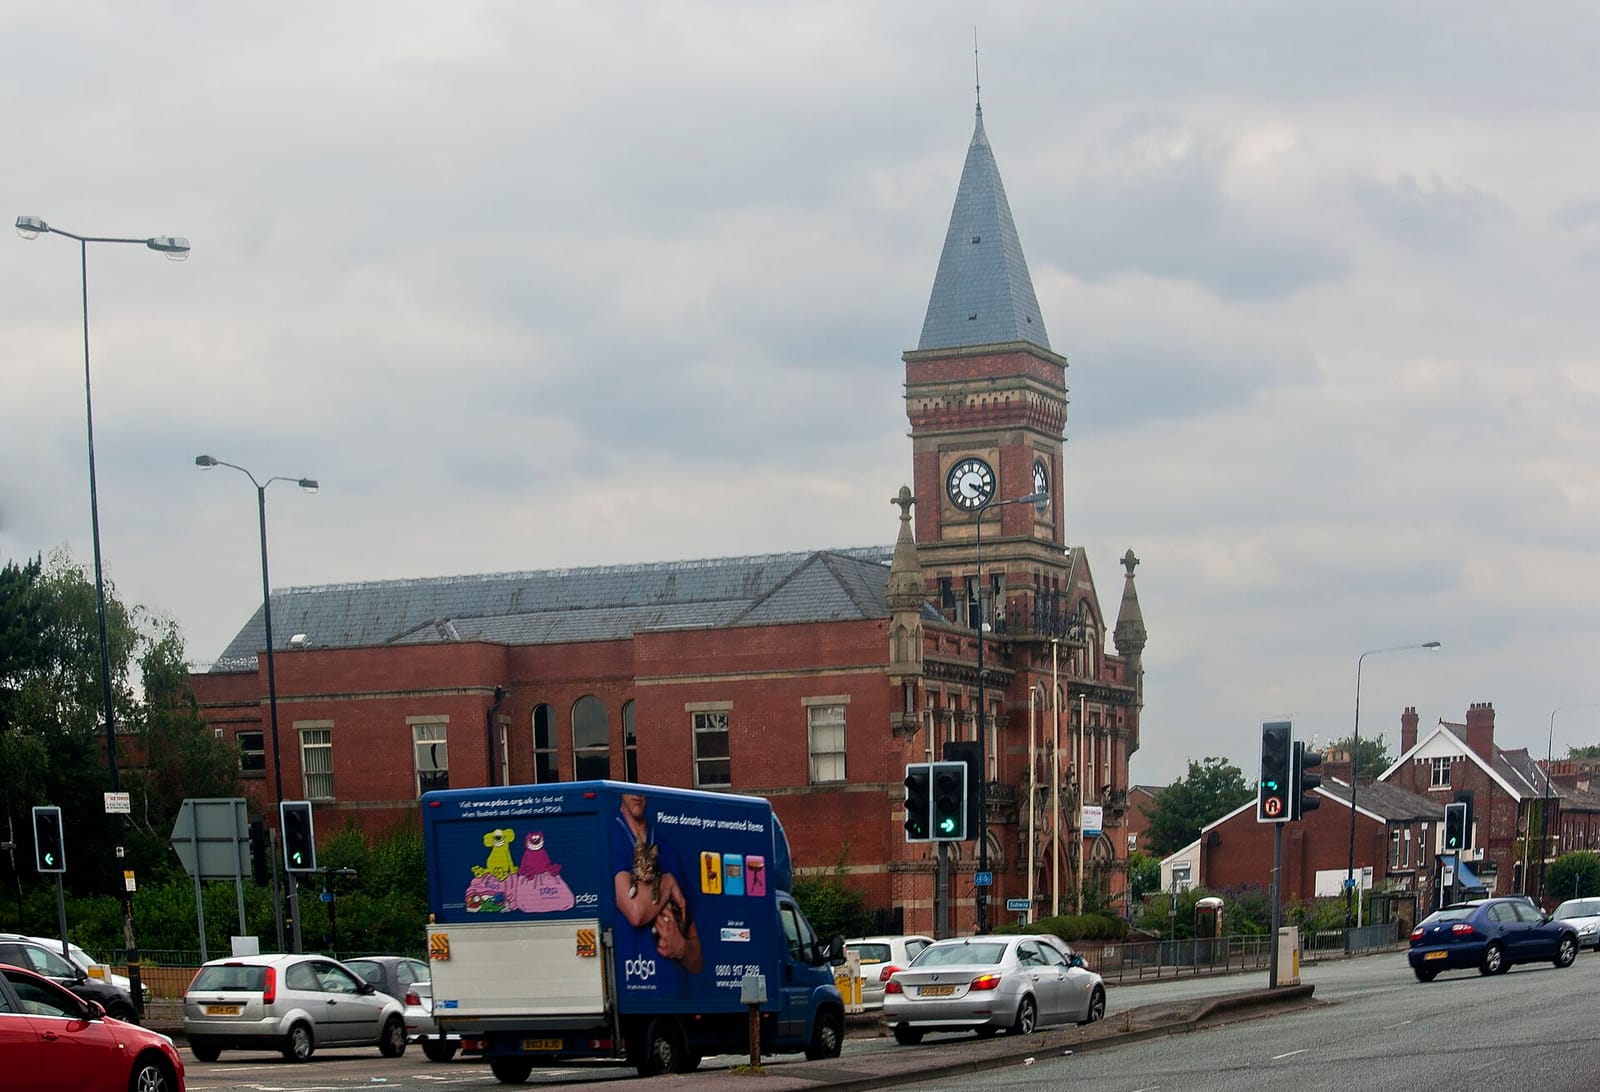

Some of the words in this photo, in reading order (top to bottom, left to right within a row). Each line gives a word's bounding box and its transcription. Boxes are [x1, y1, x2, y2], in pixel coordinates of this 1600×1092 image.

[472, 797, 534, 807] www.pdsa.org.uk
[545, 805, 562, 813] PDSA
[657, 811, 679, 824] Please
[679, 813, 702, 826] donate
[702, 819, 717, 830] your
[717, 819, 747, 831] unwanted
[747, 820, 764, 832] items
[575, 892, 598, 904] pdsa
[625, 953, 656, 981] pdsa
[715, 964, 731, 977] 0800
[732, 964, 743, 977] 917
[716, 978, 743, 990] www.pdsa
